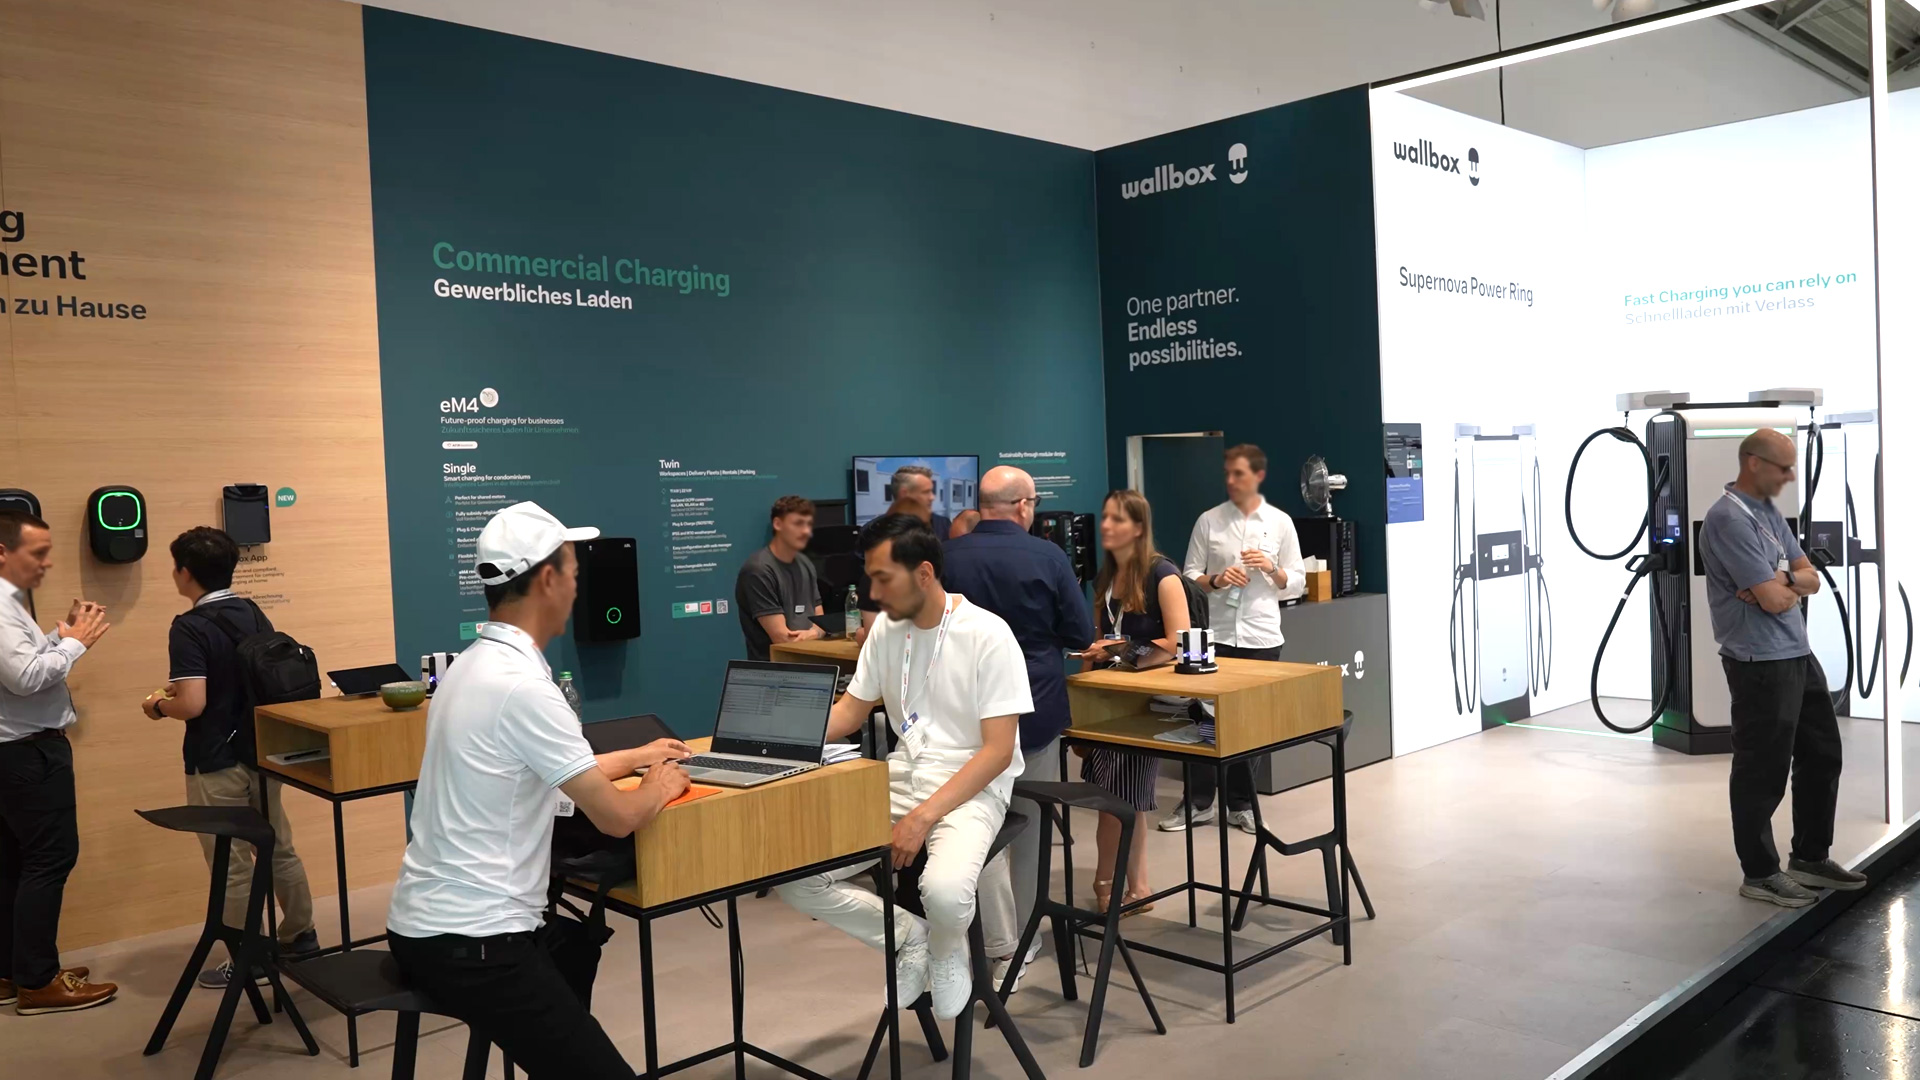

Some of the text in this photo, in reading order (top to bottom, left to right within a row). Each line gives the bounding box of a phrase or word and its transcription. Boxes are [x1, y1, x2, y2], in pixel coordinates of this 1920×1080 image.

[1394, 138, 1460, 174] wallbox
[1122, 164, 1216, 200] wallbox
[433, 242, 730, 297] Commercial Charging
[434, 278, 632, 310] Gewerbliches Laden
[1400, 266, 1533, 307] Supernova Power Ring
[1624, 272, 1857, 306] Fast Charging you can rely on
[14, 298, 48, 315] zu
[57, 295, 146, 320] Hause
[1127, 287, 1240, 316] One partner.
[1626, 296, 1814, 324] Schnellladen mit Verlass
[1128, 318, 1198, 342] Endless
[1129, 338, 1242, 372] possibilities.
[440, 397, 479, 412] eM4
[440, 416, 486, 425] Future-proof
[487, 417, 516, 425] charging
[443, 463, 476, 475] Single
[659, 459, 680, 468] Twin
